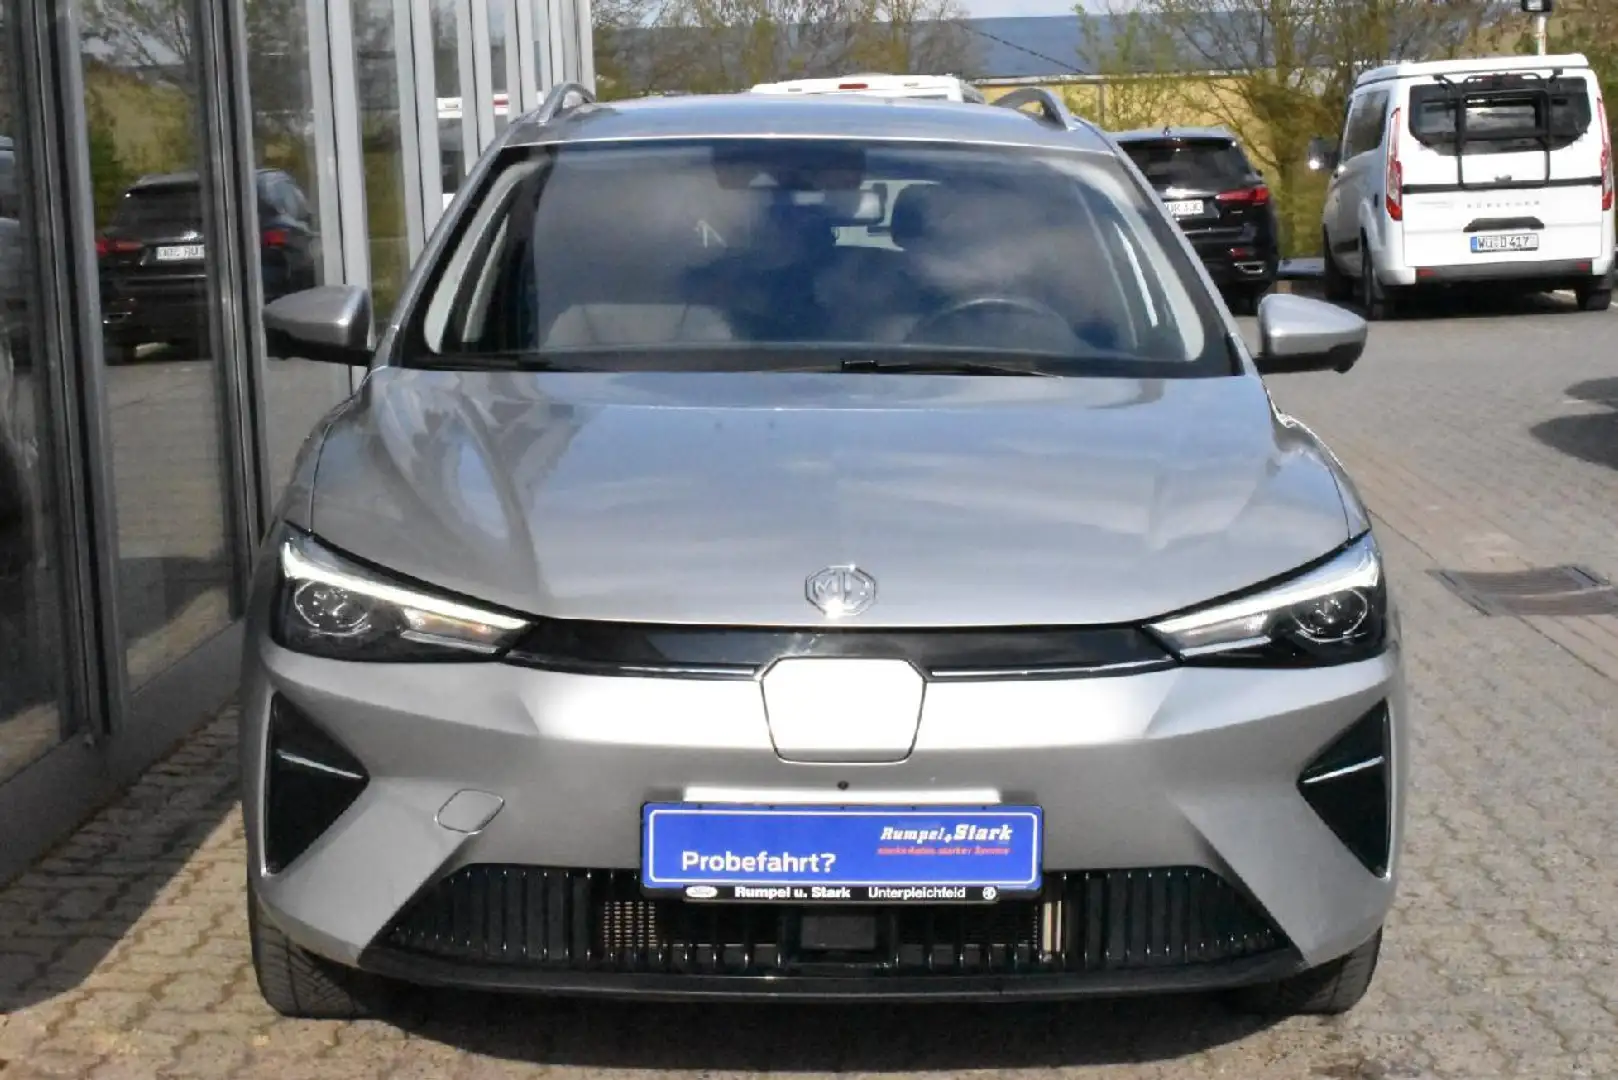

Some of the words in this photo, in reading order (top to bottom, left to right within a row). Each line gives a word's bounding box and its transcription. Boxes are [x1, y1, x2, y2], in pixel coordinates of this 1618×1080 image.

[1509, 236, 1529, 247] 417
[880, 826, 945, 844] Rumpel
[953, 824, 1012, 841] Stark
[682, 850, 837, 873] Probefahrt?
[734, 886, 791, 900] Rumpel
[793, 888, 808, 898] u.
[811, 886, 851, 899] Stark
[868, 886, 966, 900] Unterpleichfeld
